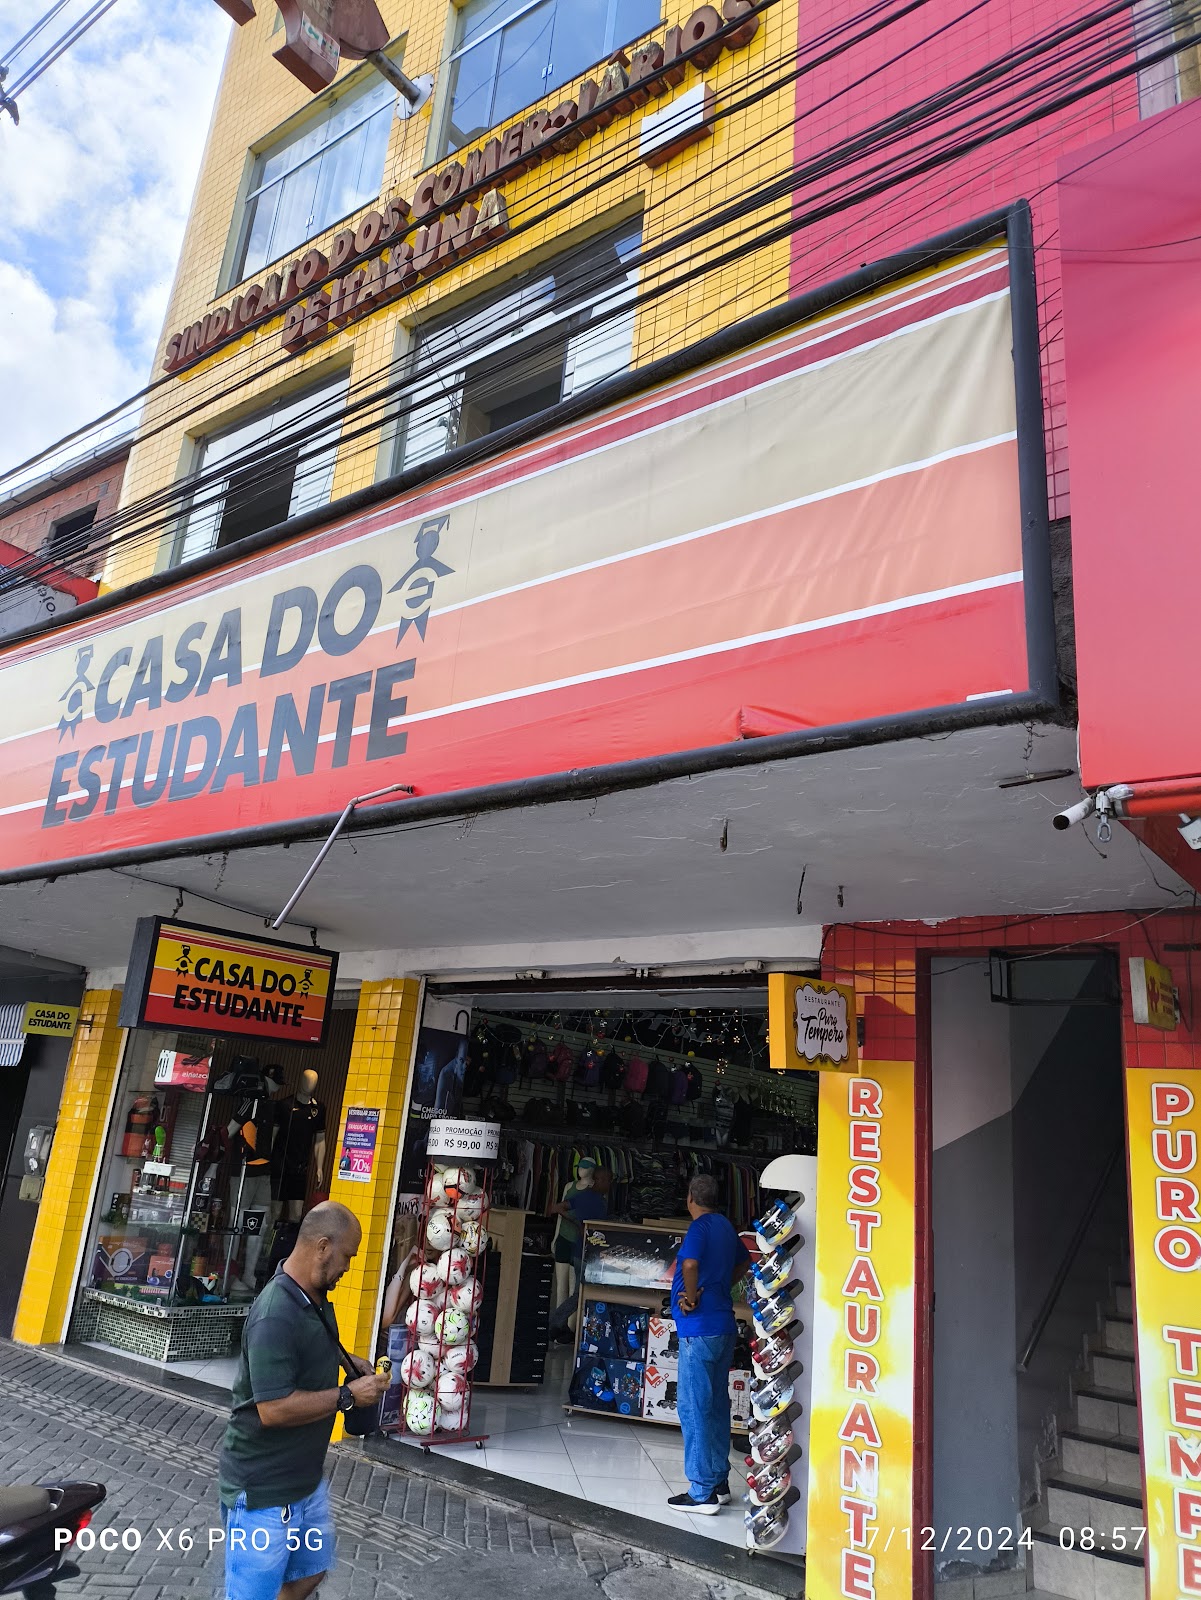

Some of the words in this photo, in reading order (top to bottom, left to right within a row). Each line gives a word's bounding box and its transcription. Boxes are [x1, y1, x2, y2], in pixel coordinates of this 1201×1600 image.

[281, 290, 330, 354] DE
[328, 188, 510, 327] ITABUNA
[162, 248, 328, 373] SINDICATO
[328, 196, 412, 274] DOS
[94, 607, 243, 723] CASA
[259, 564, 383, 679] DO
[41, 658, 416, 829] ESTUDANTE
[194, 957, 254, 991] CASA
[260, 969, 297, 997] DO
[173, 984, 304, 1028] ESTUDANTE
[804, 995, 841, 1008] RESTAURANTE
[28, 1018, 72, 1030] ESTUDANTE
[35, 1009, 56, 1019] CASA
[56, 1011, 70, 1020] DO
[817, 1007, 838, 1027] Puro
[800, 1013, 845, 1052] Tempero
[421, 1106, 448, 1115] CHEGOU
[445, 1126, 483, 1136] PROMOÇÃO
[444, 1138, 455, 1148] R$
[456, 1139, 481, 1150] 99,00
[352, 1158, 370, 1172] 70%
[1151, 1082, 1201, 1273] PURO
[655, 1322, 673, 1339] VOLLO
[839, 1077, 884, 1600] RESTAURANTE
[652, 1372, 670, 1389] VOLLO
